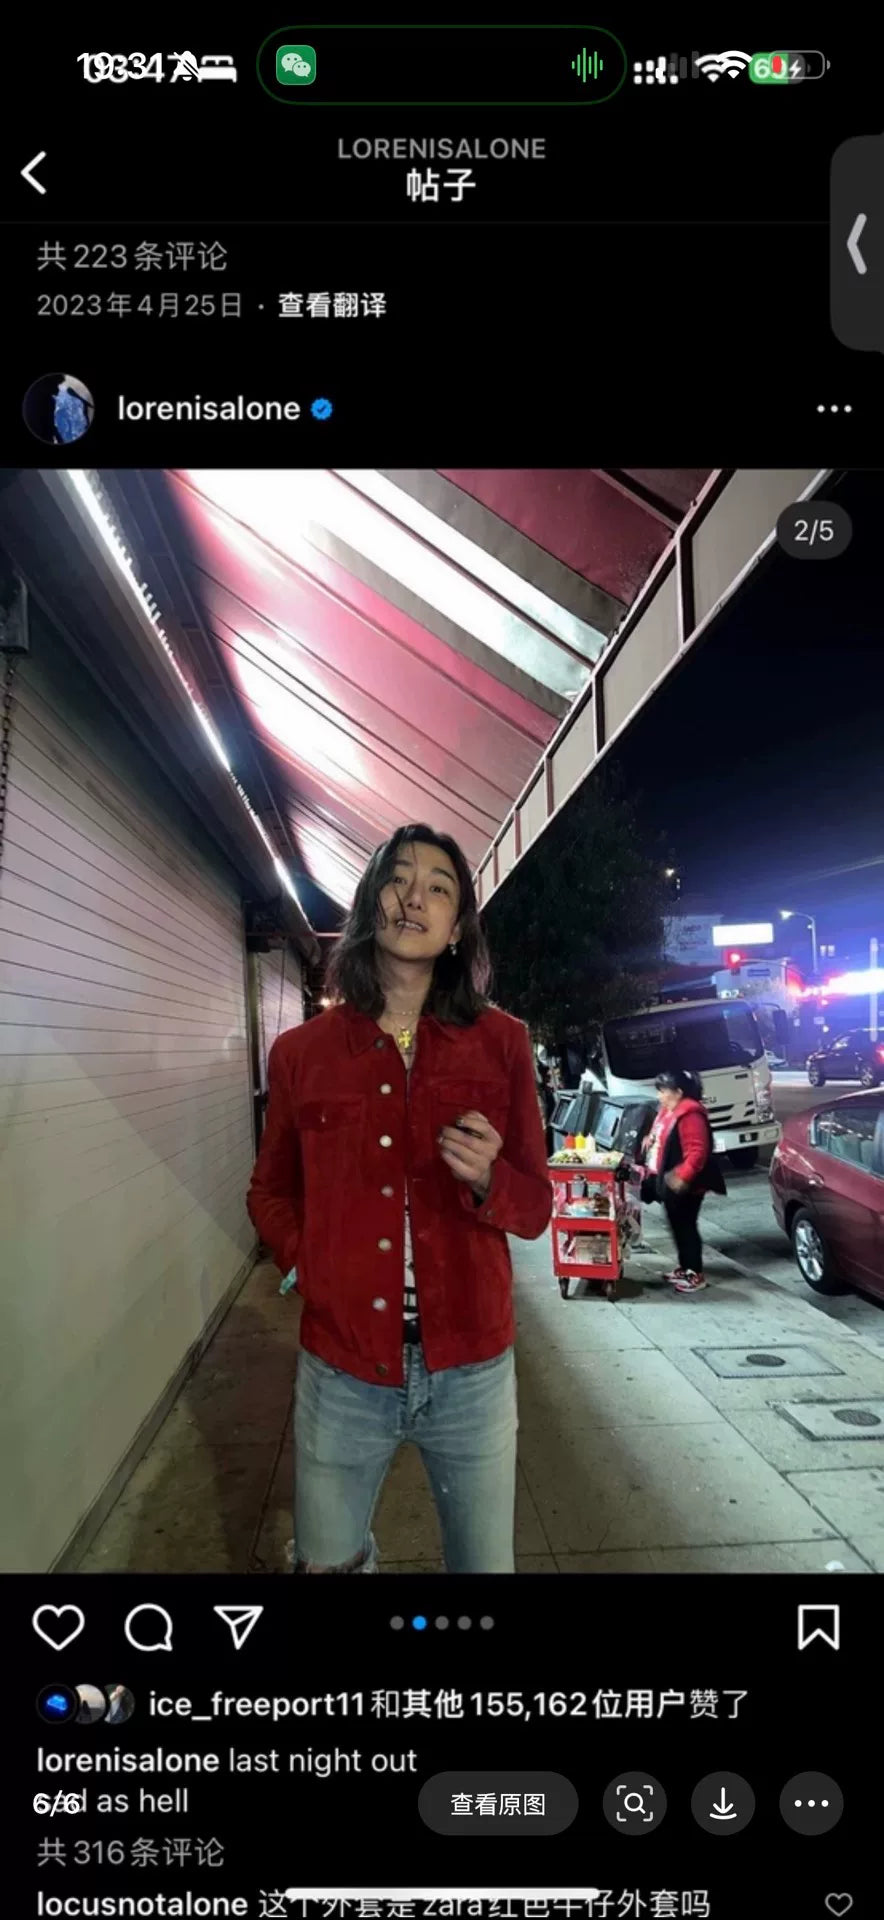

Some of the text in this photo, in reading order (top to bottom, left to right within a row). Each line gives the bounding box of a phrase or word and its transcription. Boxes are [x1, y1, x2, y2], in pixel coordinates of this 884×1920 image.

[338, 137, 546, 160] LORENISALONE
[406, 166, 477, 203] 帖子
[278, 291, 387, 319] 查看翻译
[118, 394, 301, 421] lorenisalone
[794, 519, 834, 546] 2/5
[37, 1746, 417, 1778] lorenisalone last night out
[96, 1793, 129, 1813] as
[139, 1787, 188, 1813] hell
[37, 1890, 249, 1917] locusnotalone
